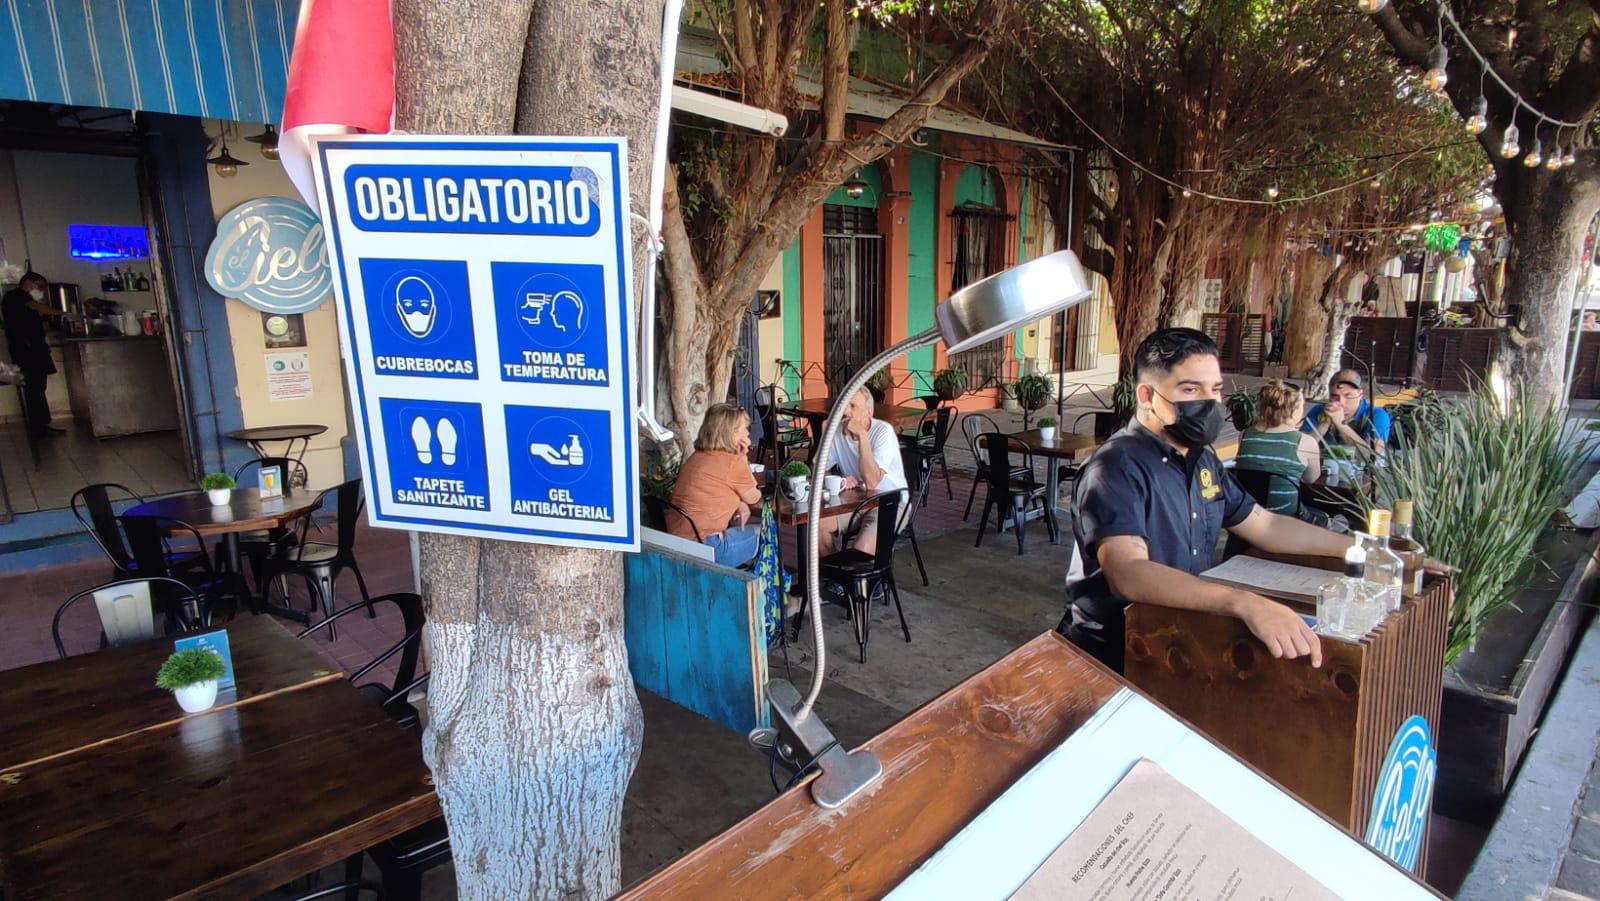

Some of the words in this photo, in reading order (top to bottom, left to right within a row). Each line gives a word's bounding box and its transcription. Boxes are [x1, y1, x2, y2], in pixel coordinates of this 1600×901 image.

[354, 176, 591, 226] OBLIGATORIO
[376, 356, 474, 374] CUBREBOCAS
[522, 351, 563, 366] TOMA
[567, 352, 585, 367] DE
[504, 364, 607, 382] TEMPERATURA
[413, 477, 465, 493] TAPETE
[397, 489, 486, 509] SANITIZANTE
[549, 488, 574, 503] GEL
[513, 499, 612, 521] ANTIBACTERIAL
[1071, 834, 1115, 883] RECOMENDACIONES
[1114, 824, 1125, 835] DEL
[1122, 811, 1135, 825] CHEF
